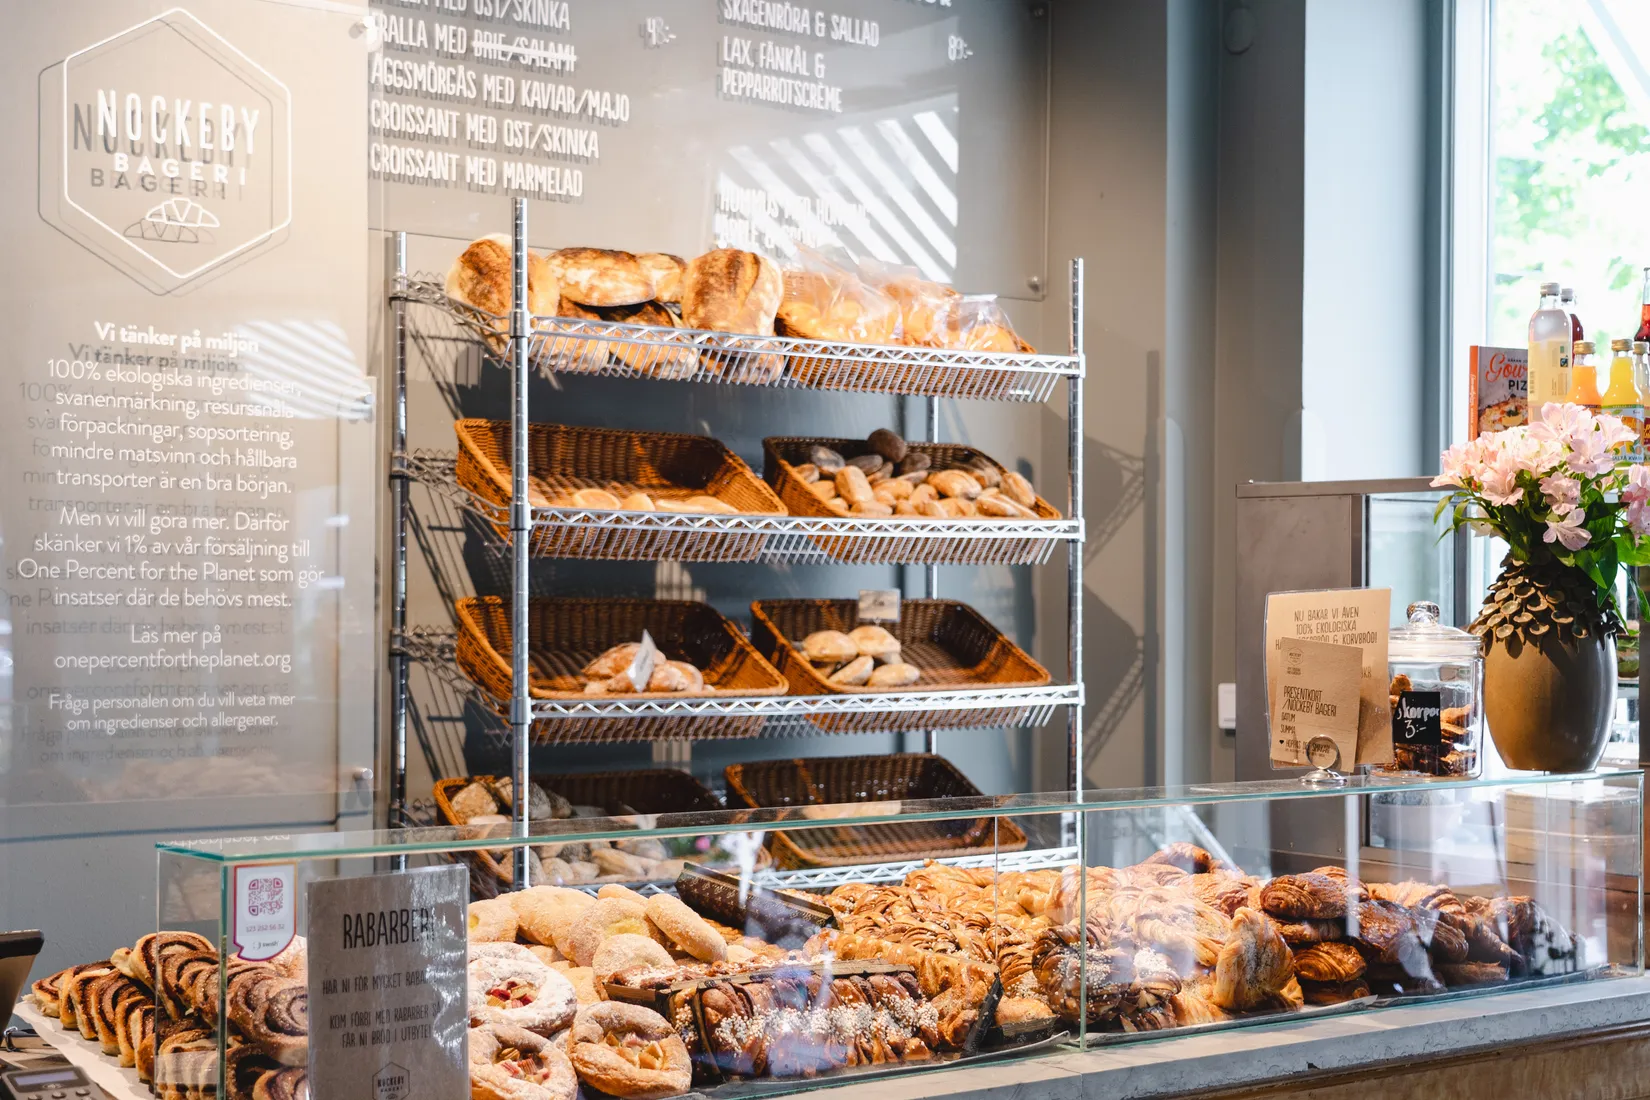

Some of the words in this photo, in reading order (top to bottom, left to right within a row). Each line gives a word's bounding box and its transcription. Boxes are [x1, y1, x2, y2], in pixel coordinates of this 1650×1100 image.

[815, 10, 826, 37] &
[831, 14, 880, 47] SALLAD
[435, 23, 467, 54] MED
[473, 29, 576, 72] BRIE/SALAMI
[723, 36, 755, 68] LAX,
[815, 52, 826, 78] &
[483, 74, 515, 104] MED
[521, 79, 630, 122] KAVIAR/MAJO
[97, 89, 260, 154] NOCKEBY
[371, 99, 460, 138] CROISSANT
[466, 113, 497, 143] MED
[503, 119, 600, 159] OST/SKINKA
[114, 152, 247, 185] BAGERI
[371, 143, 460, 182] CROISSANT
[465, 155, 497, 186] MED
[503, 161, 583, 197] MARMELAD
[94, 321, 115, 341] Vi
[120, 325, 177, 346] tänker
[181, 330, 202, 354] på
[47, 359, 101, 381] 100%
[106, 364, 193, 392] ekologiska
[197, 370, 302, 396] ingredienser,
[56, 392, 200, 420] svanenmärkning,
[60, 412, 183, 444] förpackningar,
[188, 424, 294, 450] sopsortering,
[52, 440, 114, 460] mindre
[119, 445, 195, 464] matsvinn
[200, 447, 231, 466] och
[236, 448, 297, 469] hållbara
[56, 470, 156, 493] transporter
[160, 471, 176, 488] är
[180, 477, 202, 490] en
[206, 472, 232, 491] bra
[236, 474, 292, 500] början.
[60, 506, 101, 526] Men
[106, 509, 120, 526] vi
[124, 508, 146, 527] vill
[150, 510, 188, 535] göra
[192, 516, 230, 530] mer.
[235, 511, 290, 531] Därför
[34, 532, 103, 552] skänker
[107, 535, 120, 553] vi
[124, 534, 148, 554] 1%
[152, 541, 171, 554] av
[176, 536, 201, 554] vår
[204, 536, 289, 564] försäljning
[292, 539, 310, 557] till
[18, 558, 61, 578] One
[66, 559, 136, 580] Percent
[140, 560, 165, 580] for
[170, 562, 198, 581] the
[203, 562, 256, 582] Planet
[260, 570, 294, 582] som
[298, 564, 325, 589] gör
[55, 587, 122, 605] insatser
[127, 587, 155, 606] där
[159, 587, 180, 606] de
[184, 587, 243, 607] behövs
[247, 592, 292, 607] mest.
[1294, 610, 1305, 622] NU
[1307, 608, 1329, 621] BAKAR
[1331, 607, 1339, 620] VI
[1296, 623, 1313, 635] 100%
[1316, 620, 1357, 634] EKOLOGISKA
[131, 625, 159, 644] Läs
[163, 630, 198, 644] mer
[202, 624, 222, 650] på
[55, 649, 292, 675] onepercentfortheplanet.org
[49, 693, 89, 716] Fråga
[93, 693, 168, 714] personalen
[172, 695, 195, 708] om
[198, 692, 215, 708] du
[218, 692, 235, 707] vill
[237, 693, 267, 707] veta
[269, 694, 296, 706] mer
[1283, 686, 1323, 702] PRESENTKORT
[67, 718, 91, 731] om
[94, 714, 180, 735] ingredienser
[182, 712, 208, 727] och
[211, 711, 279, 732] allergener.
[1315, 703, 1337, 717] BAGERI
[322, 979, 338, 996] HAR
[342, 978, 350, 993] NI
[372, 972, 402, 990] MYCKET
[329, 1014, 347, 1030] KOM
[375, 1008, 391, 1024] MED
[394, 1005, 429, 1023] RABARBER
[359, 1031, 368, 1046] NI
